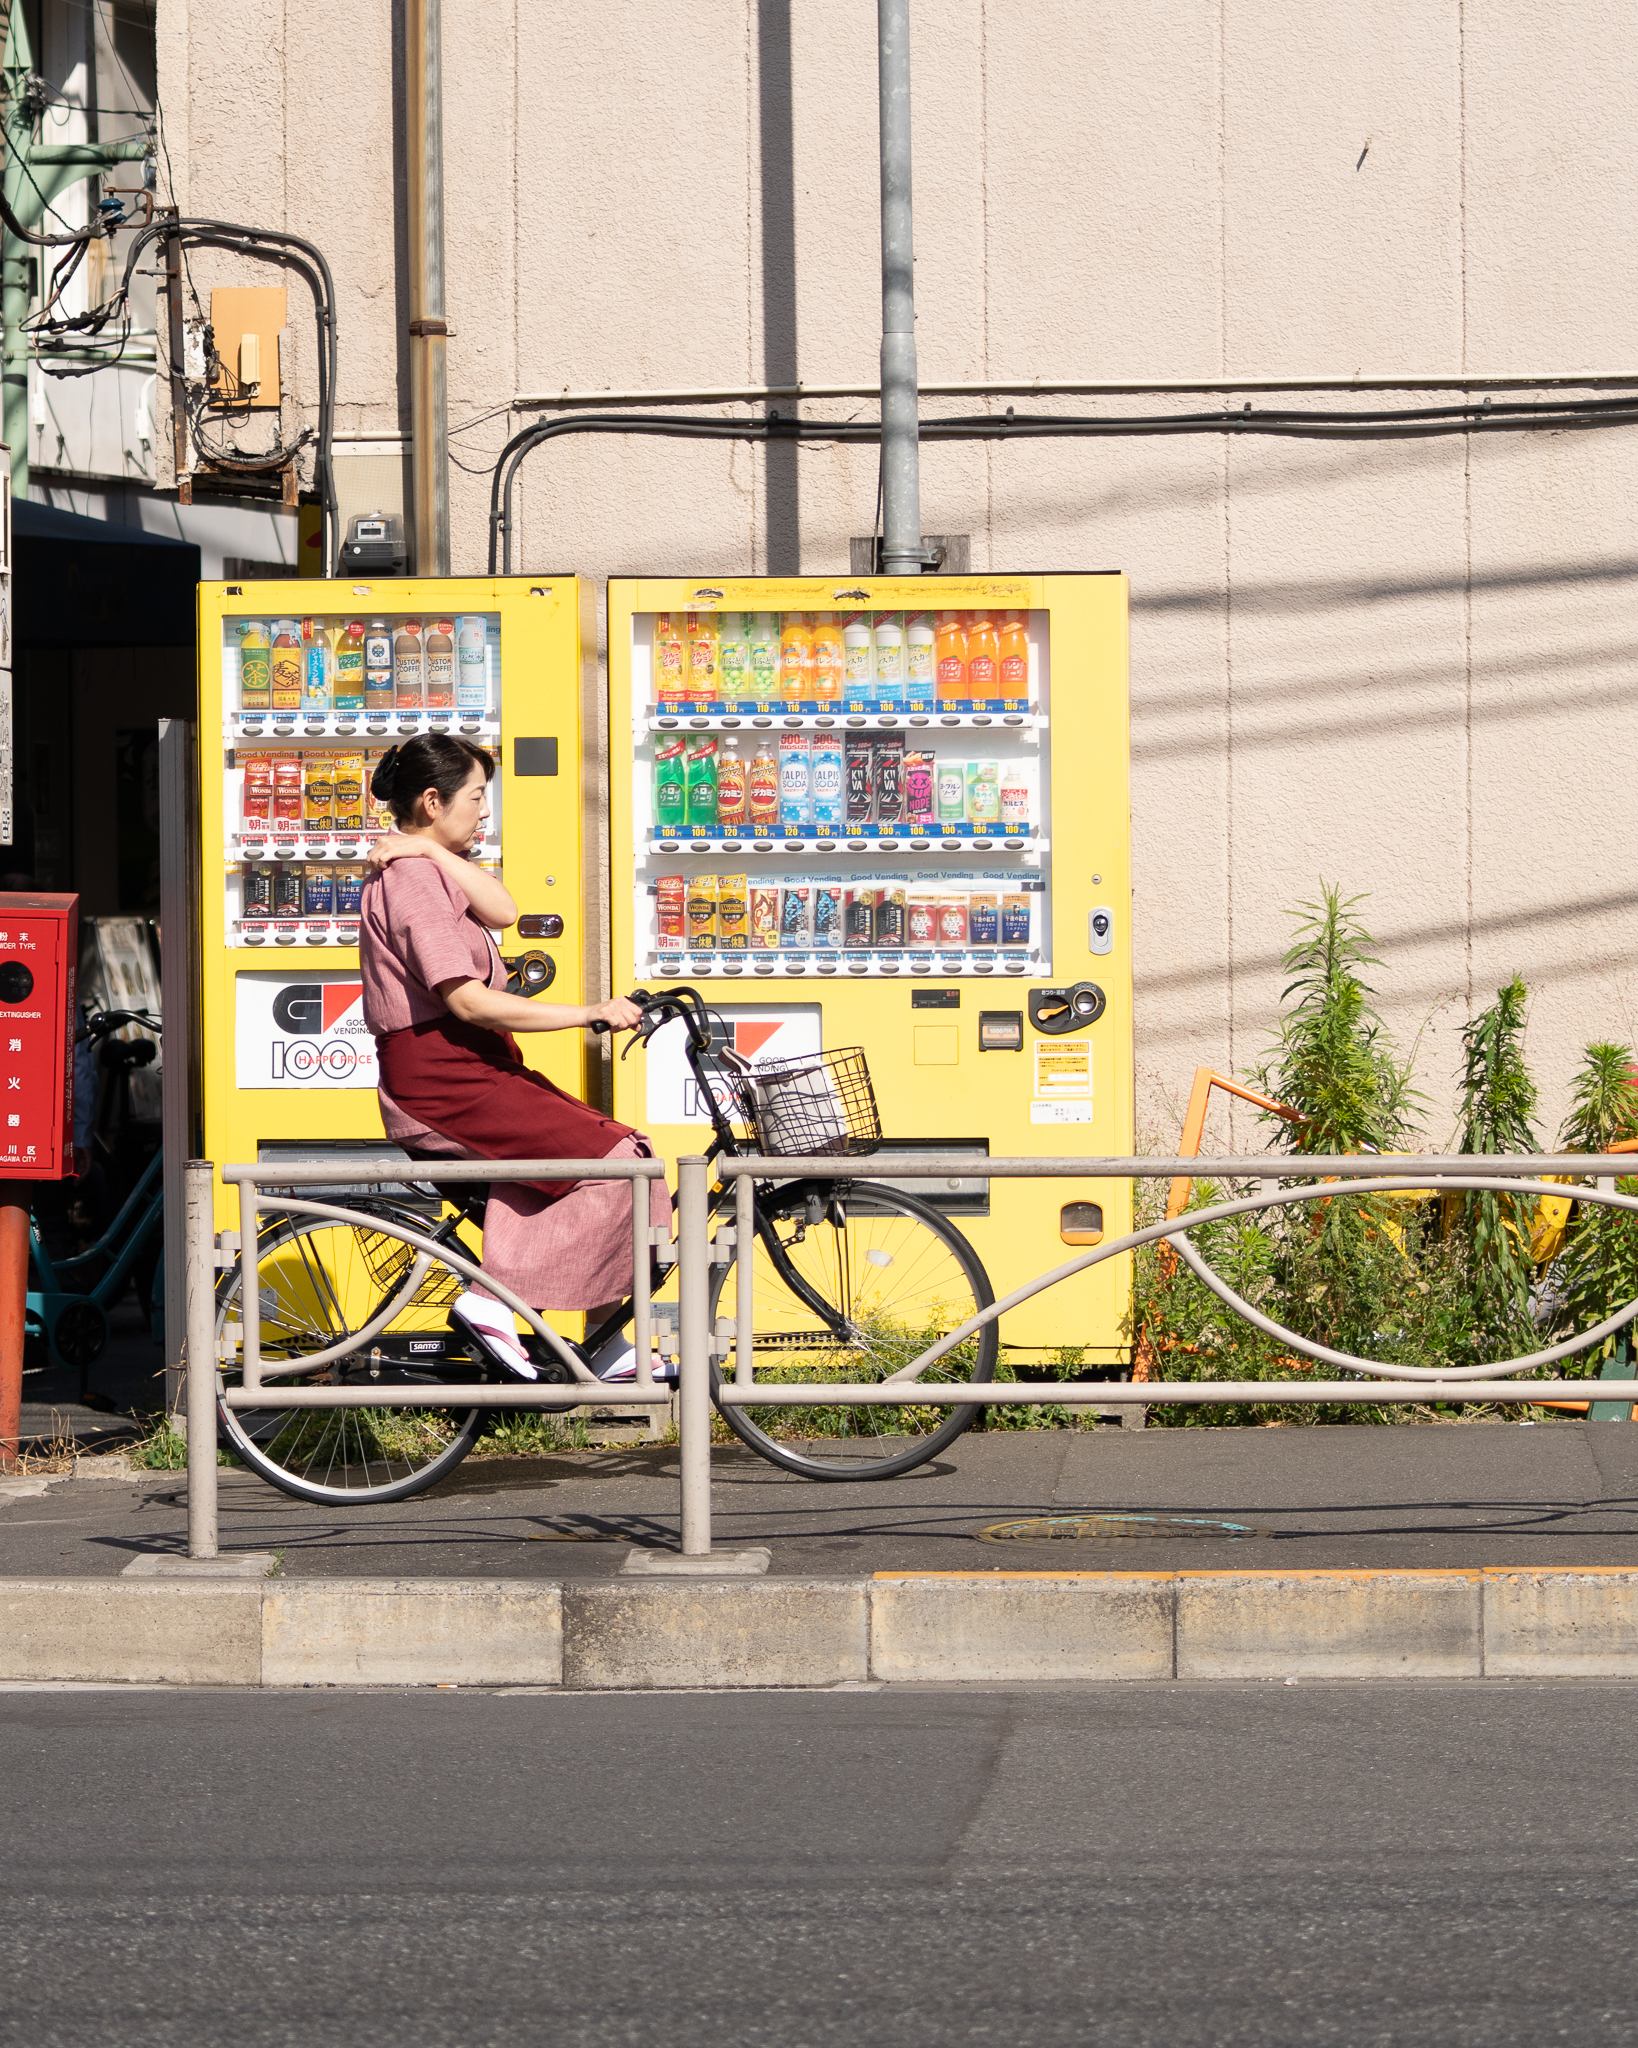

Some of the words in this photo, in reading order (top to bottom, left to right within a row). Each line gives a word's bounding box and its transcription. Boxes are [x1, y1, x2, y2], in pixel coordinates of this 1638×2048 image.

[260, 751, 294, 759] Vending
[304, 750, 326, 758] Good
[783, 780, 807, 788] SODA
[815, 780, 839, 788] SODA
[852, 780, 863, 790] VA
[884, 780, 895, 790] VA
[874, 873, 908, 881] Vending
[940, 872, 974, 880] Vending
[1006, 872, 1040, 880] Vending
[748, 876, 775, 886] ending
[18, 942, 36, 950] TYPE
[272, 1040, 357, 1080] 100
[299, 1056, 336, 1064] HAPPY
[340, 1054, 372, 1064] PRICE
